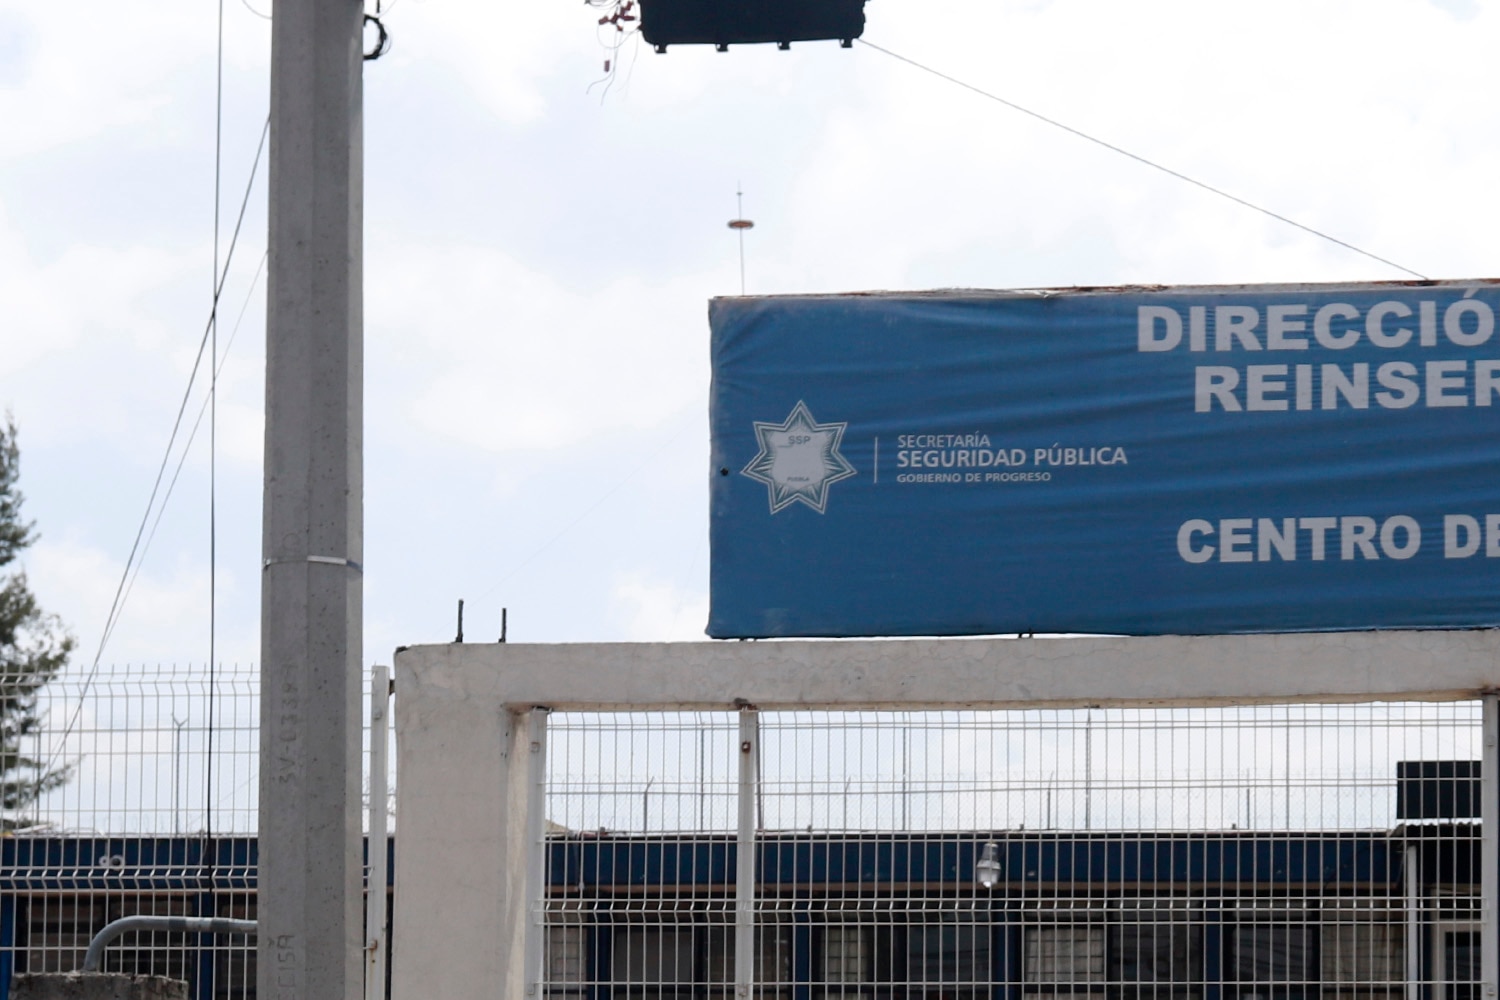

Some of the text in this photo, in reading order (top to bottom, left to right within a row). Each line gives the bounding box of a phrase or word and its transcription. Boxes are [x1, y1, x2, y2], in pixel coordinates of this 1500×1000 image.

[787, 434, 812, 445] SSP
[897, 430, 992, 448] SECRETARÍA
[897, 442, 1129, 468] SEGURIDAD PÚBLICA
[896, 471, 1053, 484] GOBIERNO DE PROGRESO
[1176, 514, 1422, 565] CENTRO
